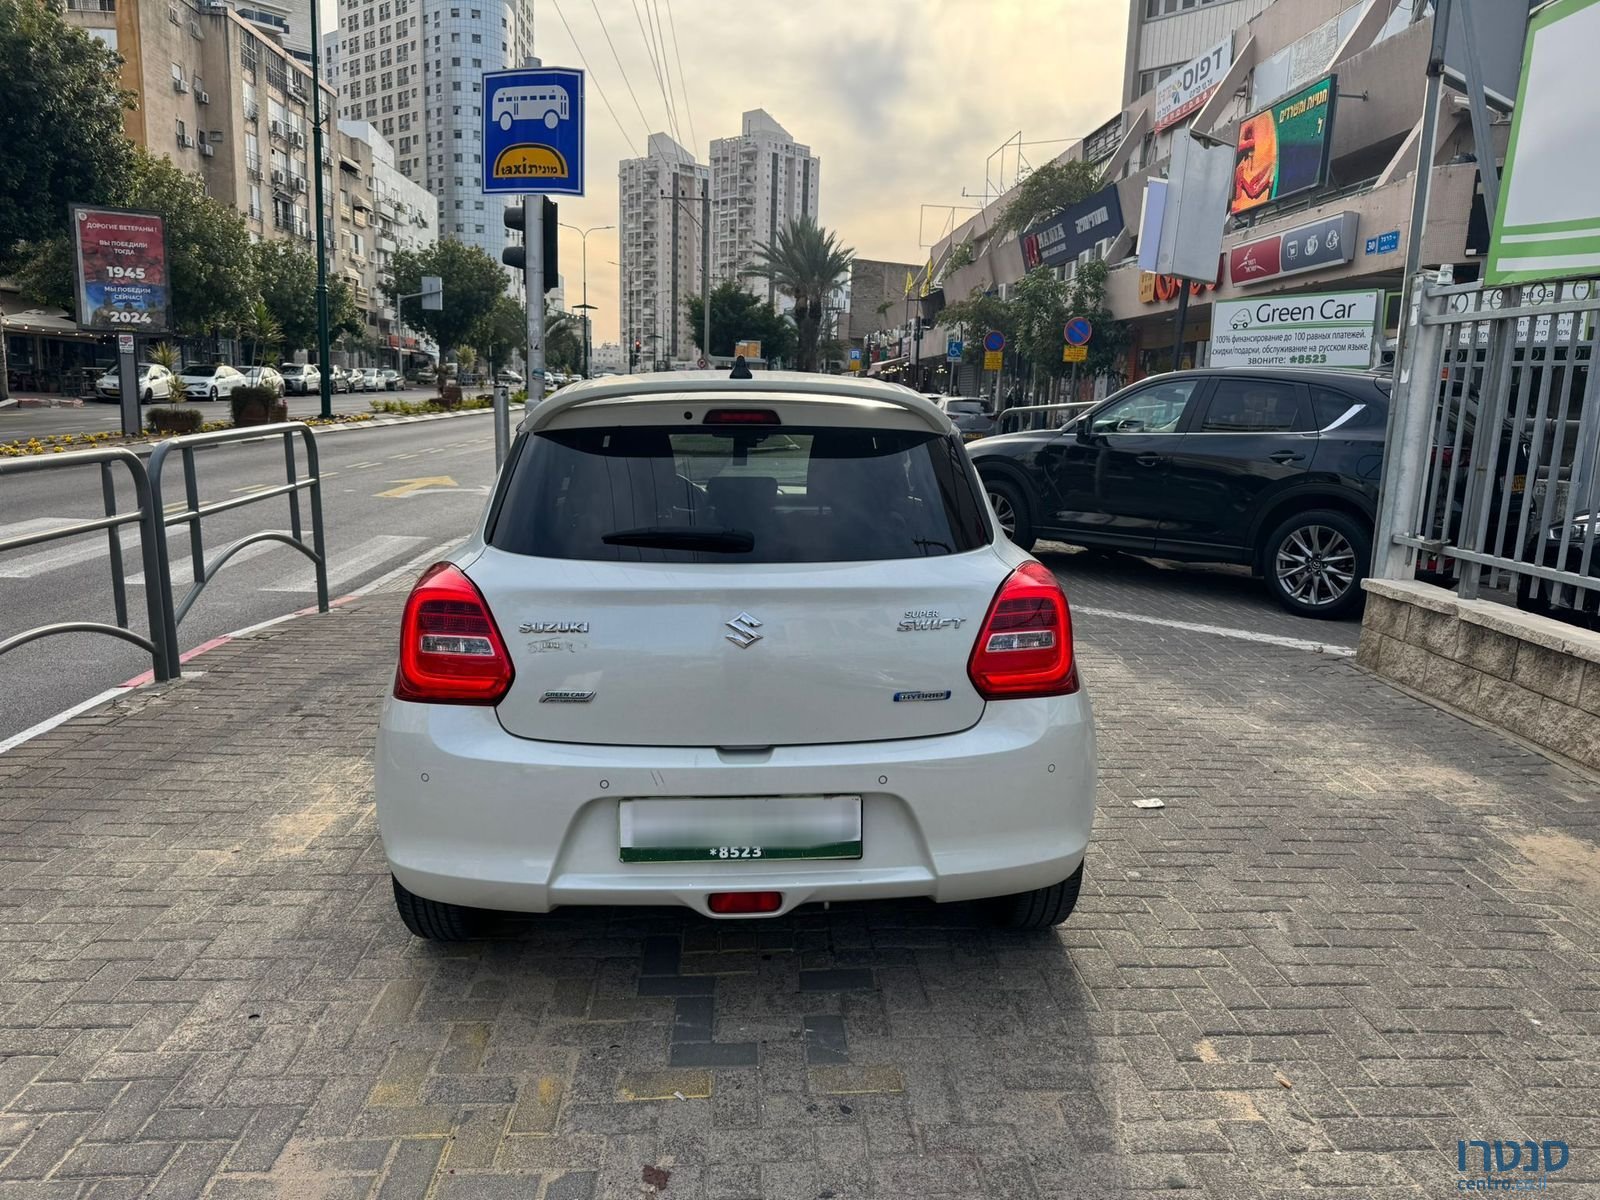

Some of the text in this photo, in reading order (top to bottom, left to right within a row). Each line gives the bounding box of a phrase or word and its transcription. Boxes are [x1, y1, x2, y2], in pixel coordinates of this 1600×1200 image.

[1183, 46, 1223, 91] דפוס
[501, 157, 558, 175] taxi מונית
[86, 222, 118, 231] ДОРОГИЕ
[118, 225, 154, 233] ВЕТЕРАНЫ
[111, 241, 148, 249] ПОБЕДИЛИ
[1367, 241, 1375, 251] 30
[114, 248, 135, 256] ТОГДА
[106, 265, 146, 279] 1945
[1256, 299, 1356, 323] Green Car
[109, 311, 153, 324] 2024
[1215, 329, 1366, 345] 100% финансирование до 100 равных платежей.
[1262, 344, 1308, 355] обслуживание
[1318, 344, 1346, 354] русском
[1347, 343, 1370, 351] языке.
[1247, 356, 1286, 365] звоните:
[904, 609, 939, 618] SUPER
[518, 621, 589, 634] SUZUKI
[896, 618, 967, 632] SWIFT
[902, 692, 945, 700] HYBRID
